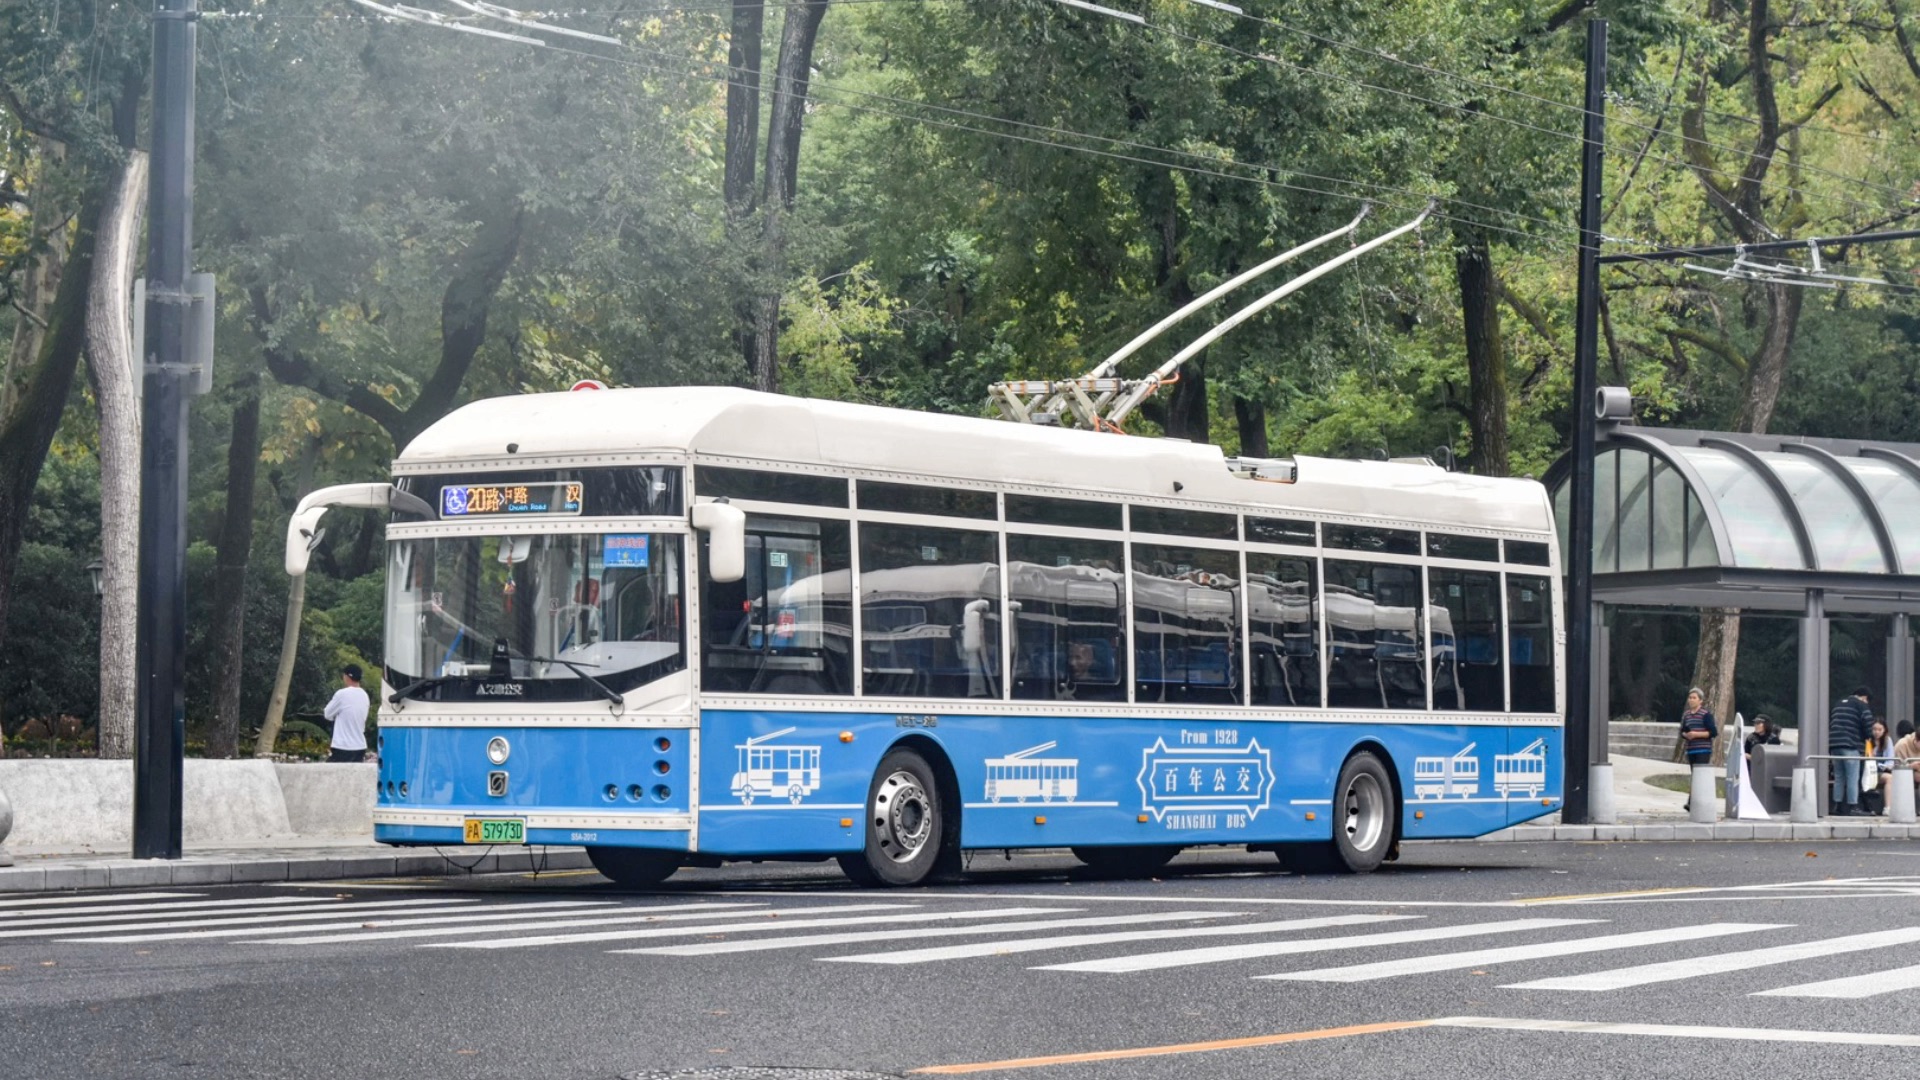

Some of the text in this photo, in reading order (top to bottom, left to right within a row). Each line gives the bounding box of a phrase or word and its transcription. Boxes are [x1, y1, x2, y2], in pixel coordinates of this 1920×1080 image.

[466, 487, 499, 512] 20路
[530, 503, 547, 511] Road
[1164, 766, 1250, 793] 百年公交
[1166, 814, 1246, 829] SHANGHAI BUS
